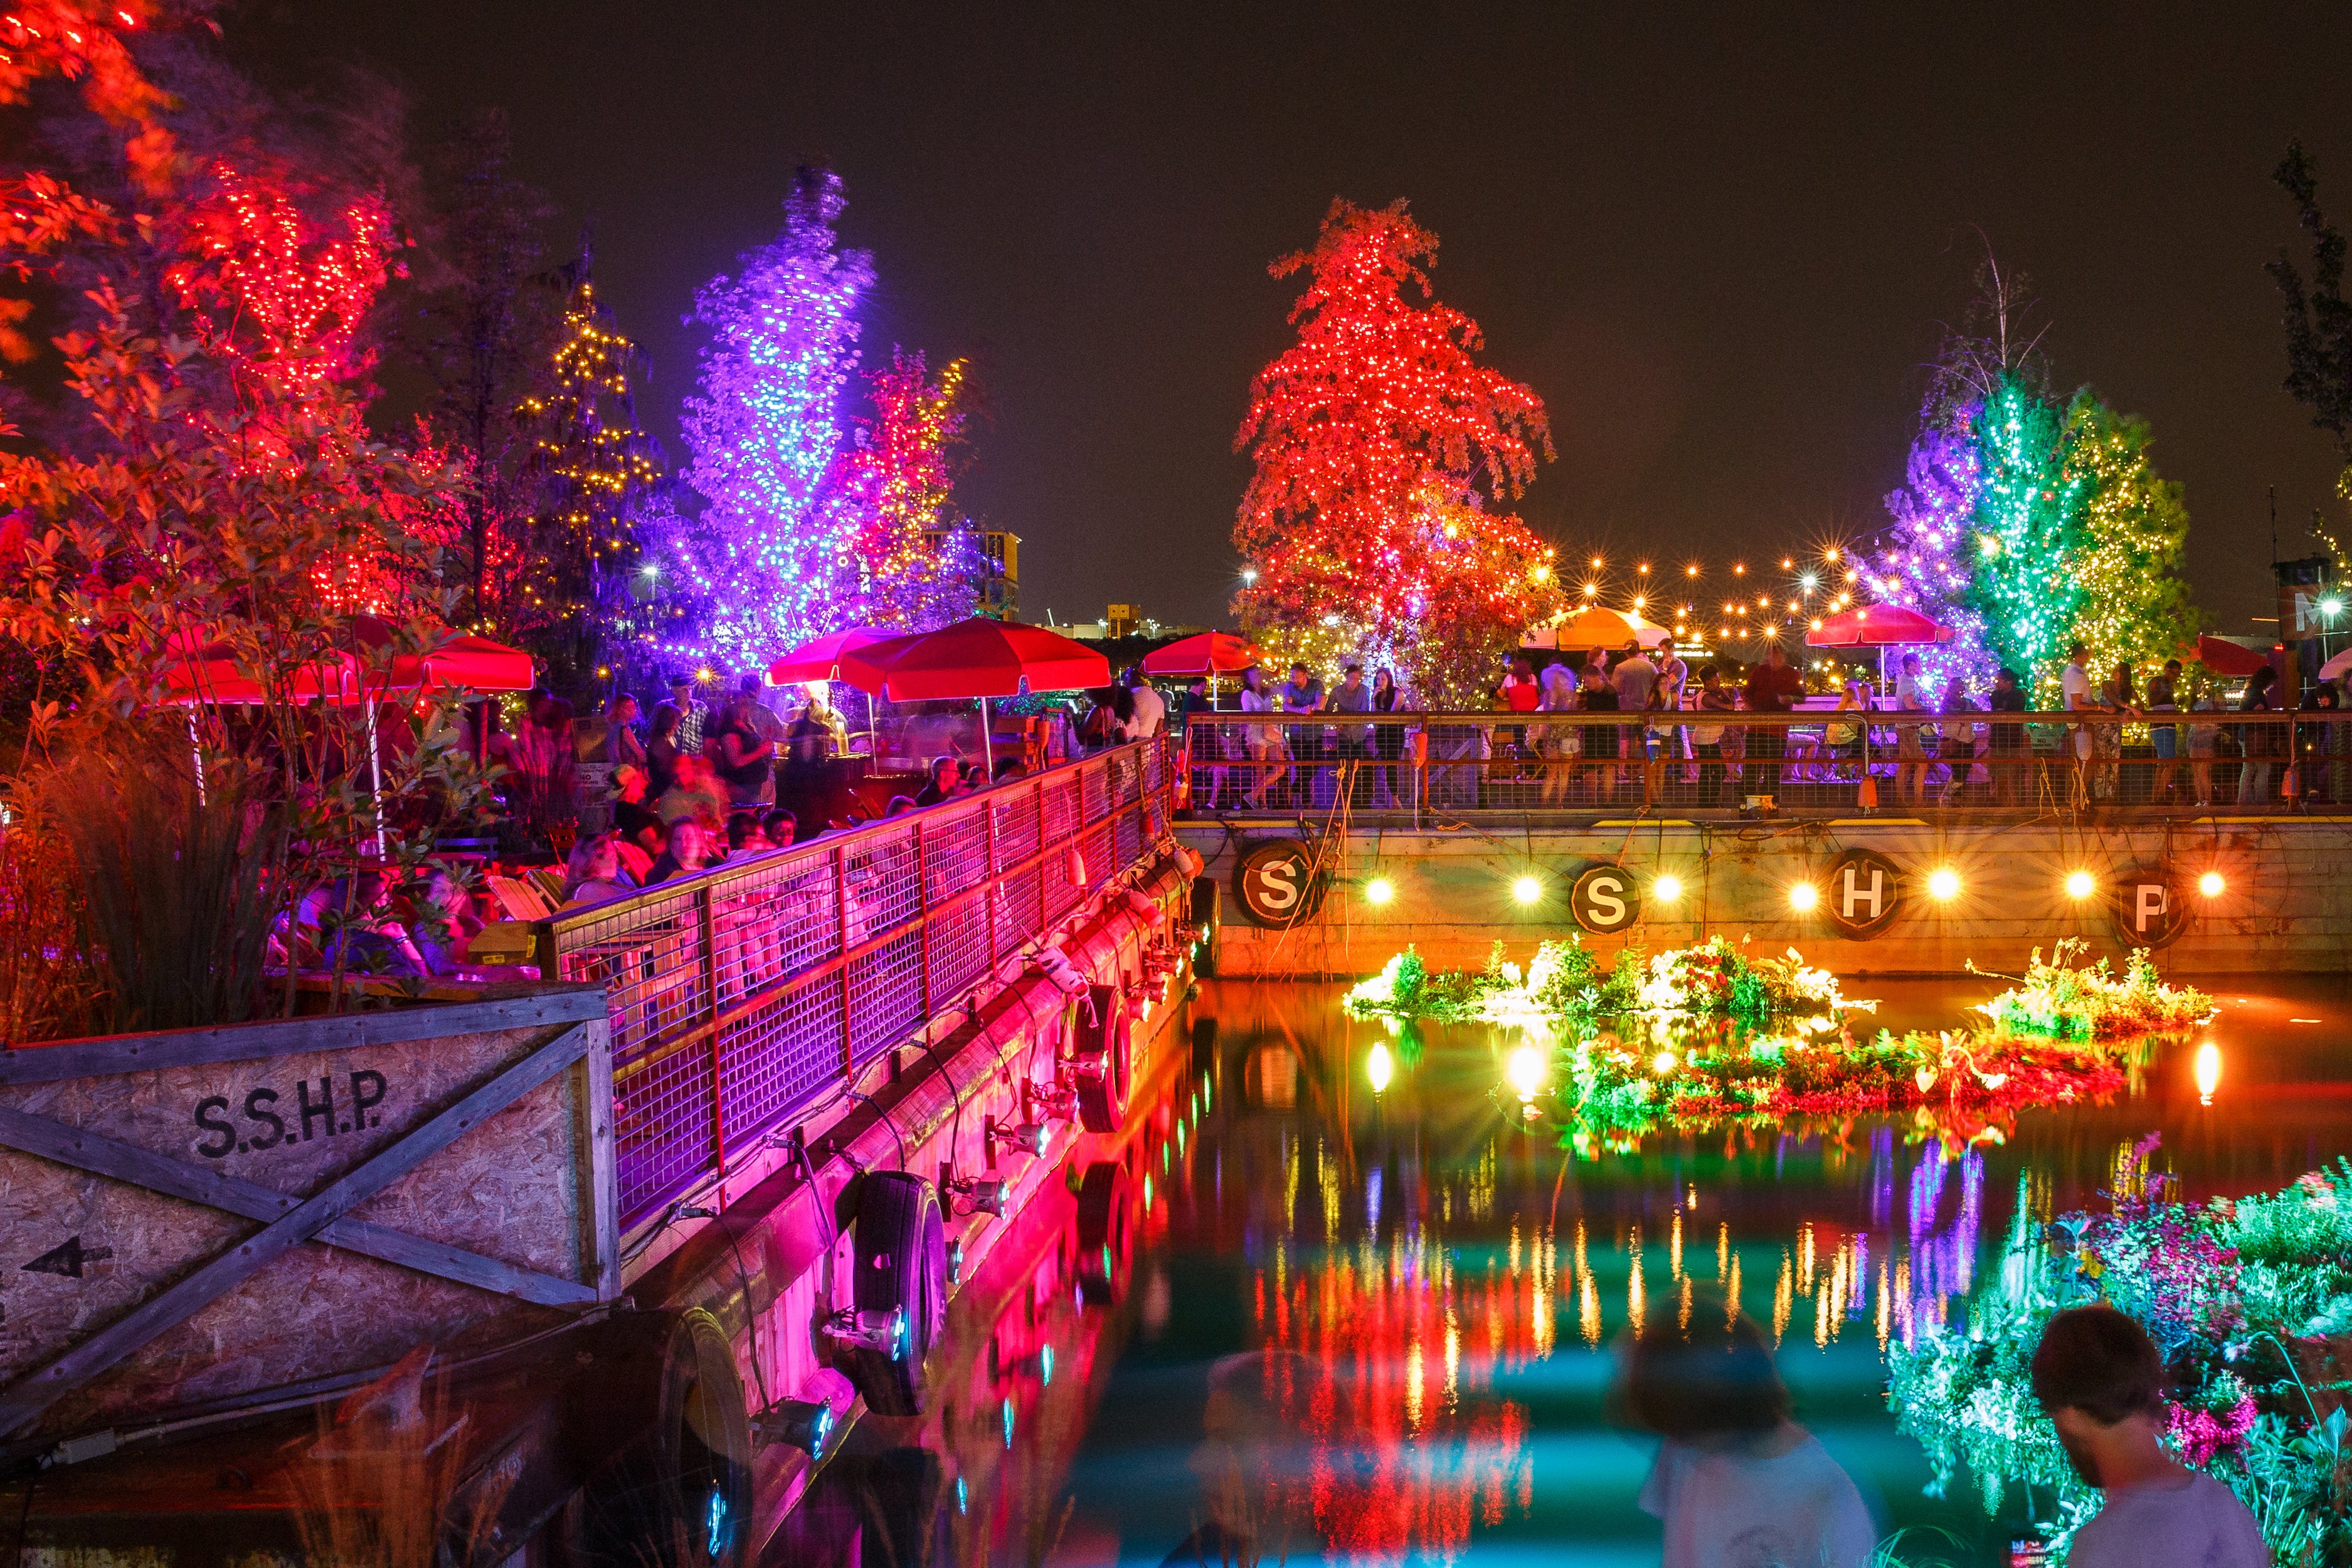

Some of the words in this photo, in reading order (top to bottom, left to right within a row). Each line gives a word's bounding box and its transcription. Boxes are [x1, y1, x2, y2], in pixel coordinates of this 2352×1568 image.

[1259, 861, 1297, 909] S
[1587, 877, 1626, 925] S
[1843, 869, 1882, 918] H
[2136, 884, 2168, 931] P
[194, 1069, 388, 1158] S.S.H.P.
